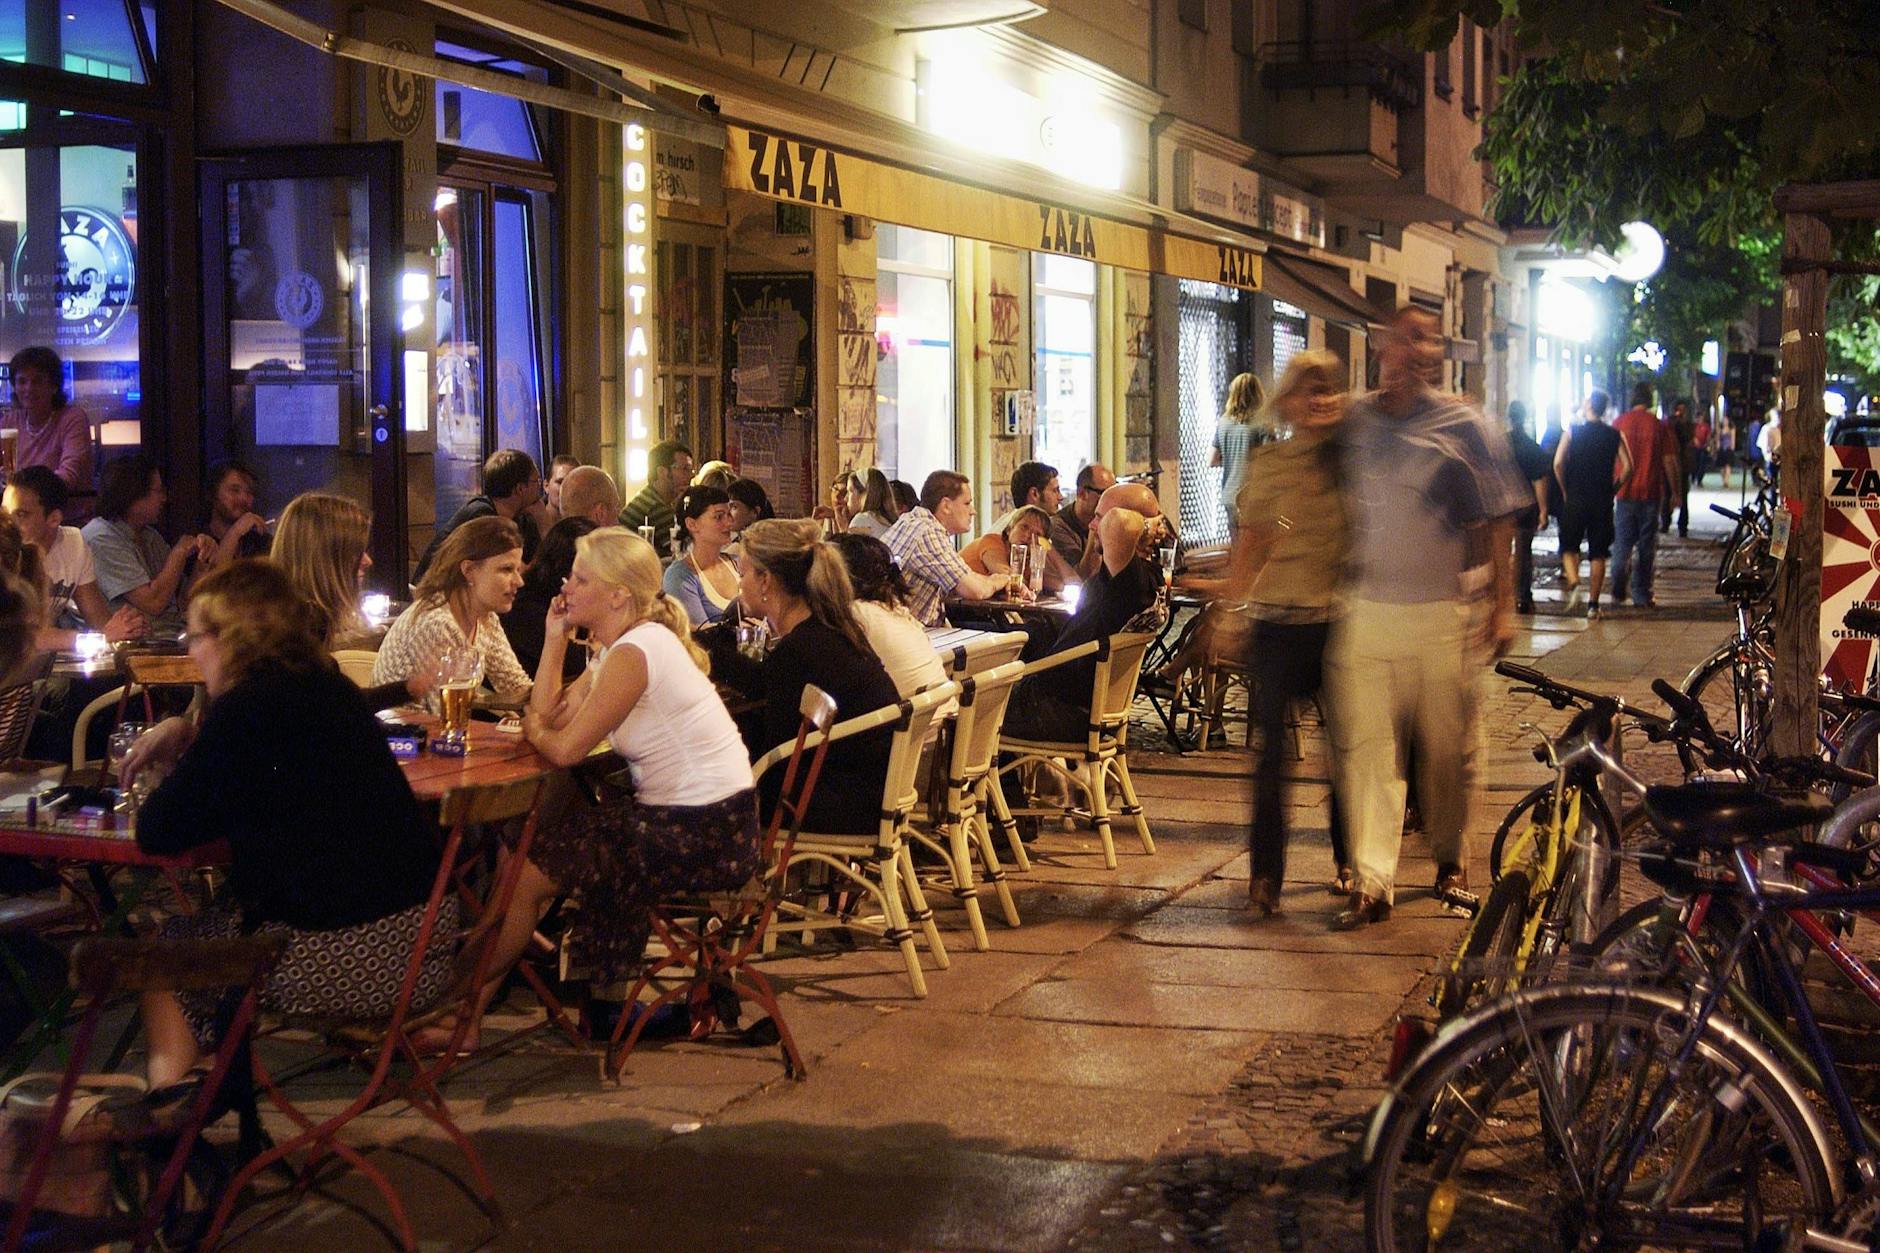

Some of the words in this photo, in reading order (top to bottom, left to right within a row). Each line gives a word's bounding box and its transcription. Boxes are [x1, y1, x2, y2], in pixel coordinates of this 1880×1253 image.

[667, 151, 695, 171] hirsch
[748, 131, 842, 208] ZAZA
[1039, 204, 1096, 259] ZAZA
[1218, 244, 1257, 287] ZAZA
[1830, 500, 1857, 509] SUSHI
[1860, 500, 1880, 509] UND
